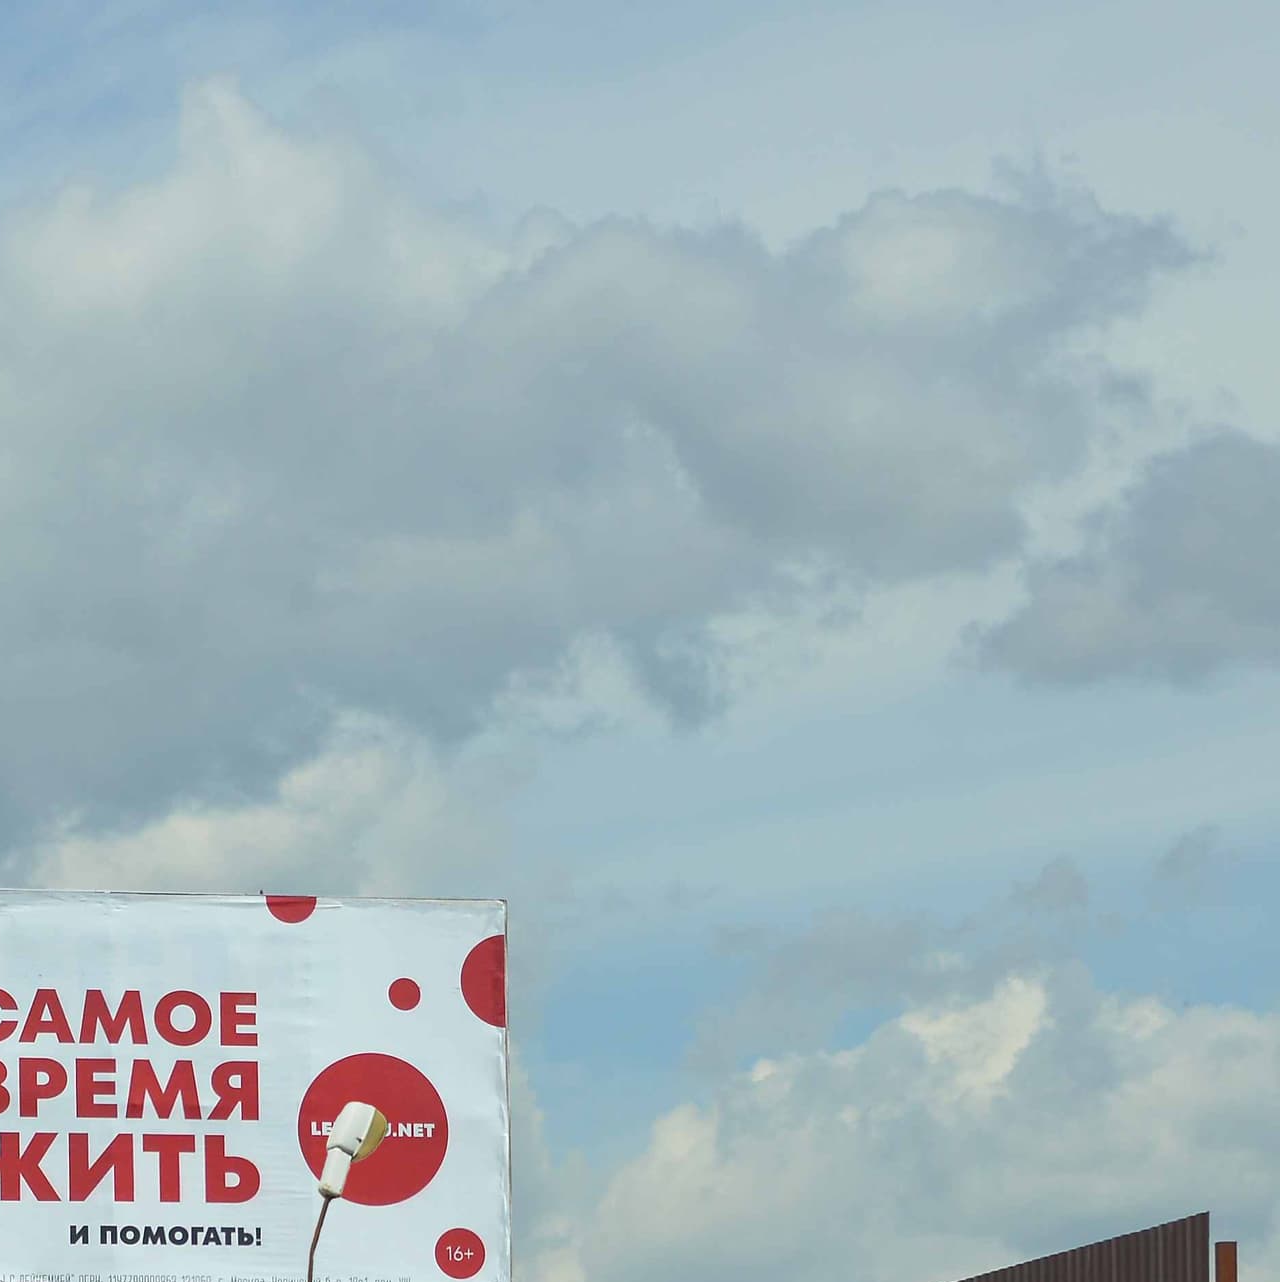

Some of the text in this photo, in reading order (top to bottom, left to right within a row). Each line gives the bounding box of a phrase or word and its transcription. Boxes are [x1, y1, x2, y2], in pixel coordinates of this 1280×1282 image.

[69, 1225, 262, 1246] И ПОМОГАТЬ!
[445, 1245, 475, 1262] 16+
